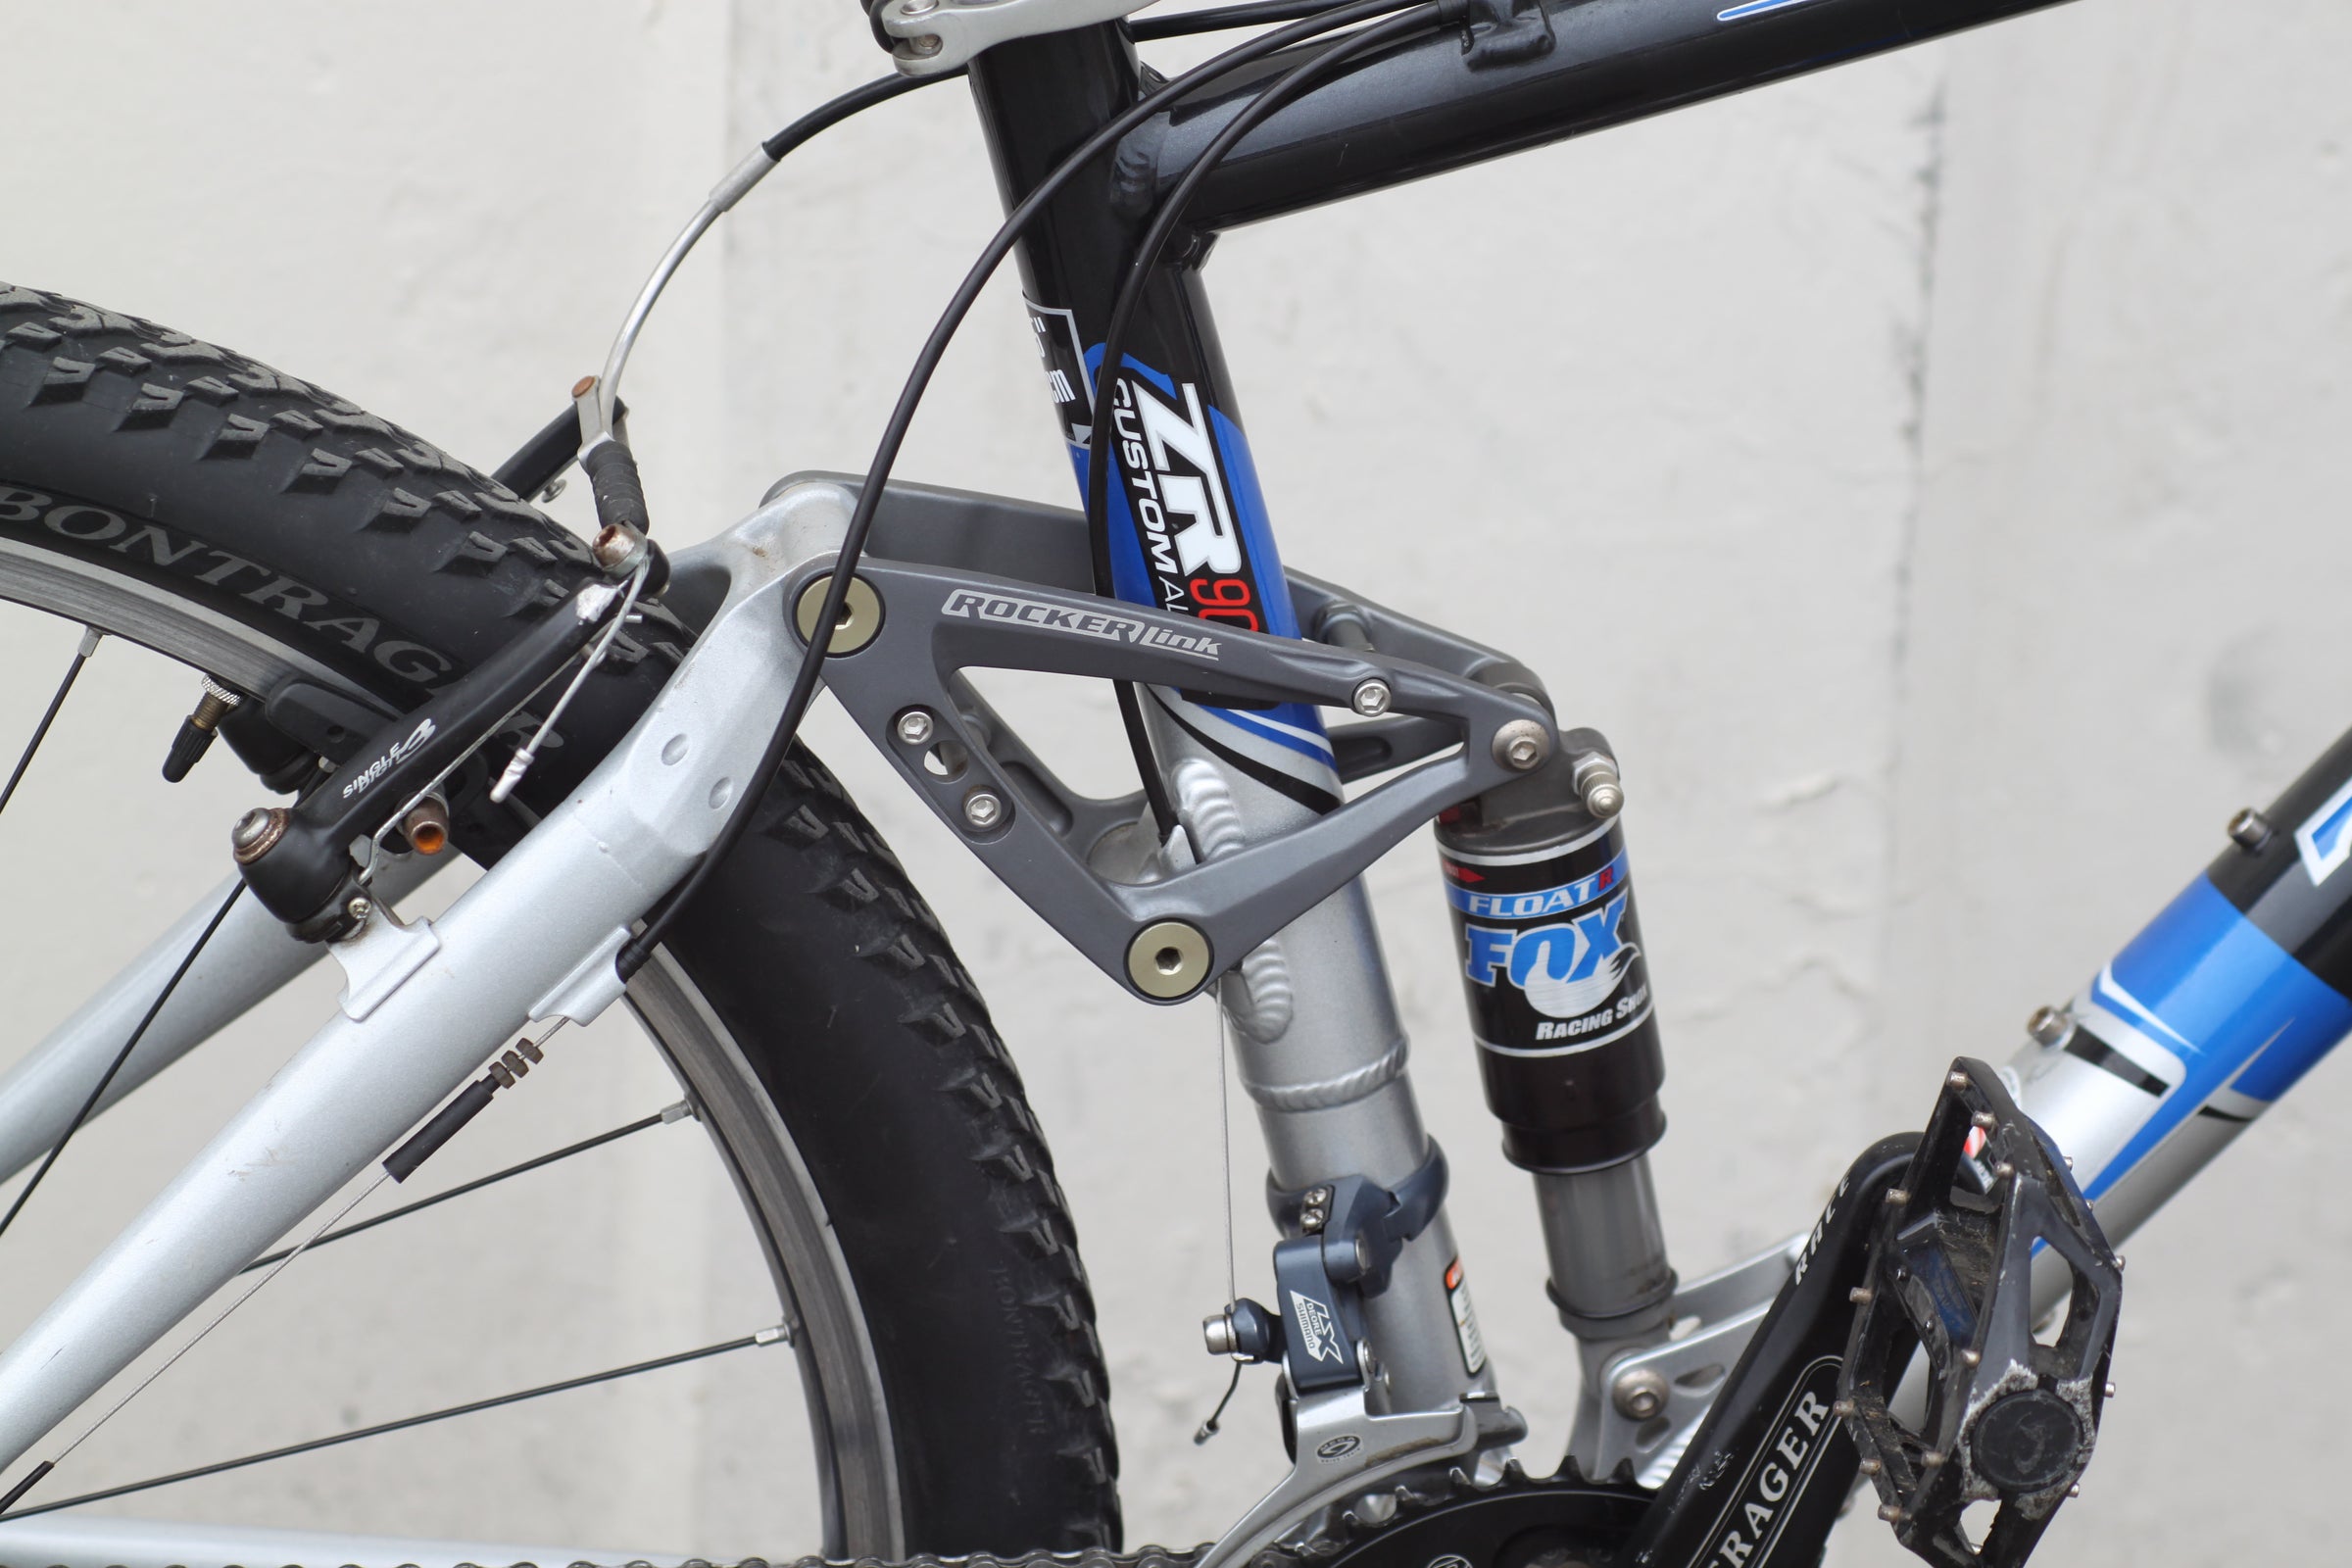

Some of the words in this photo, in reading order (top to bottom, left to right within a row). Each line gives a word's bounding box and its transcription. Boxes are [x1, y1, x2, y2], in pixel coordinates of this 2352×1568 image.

[1112, 377, 1179, 574] CUSTOM
[946, 591, 1144, 643] ROCKER
[343, 742, 400, 799] SINGLE
[1469, 876, 1596, 916] FLOAT
[1598, 866, 1614, 891] R
[1465, 887, 1630, 991] FOX
[1794, 1170, 1850, 1286] RACE
[1297, 1301, 1315, 1350] SHIMANO
[1306, 1302, 1323, 1336] DEORE
[1711, 1391, 1830, 1568] RAGER
